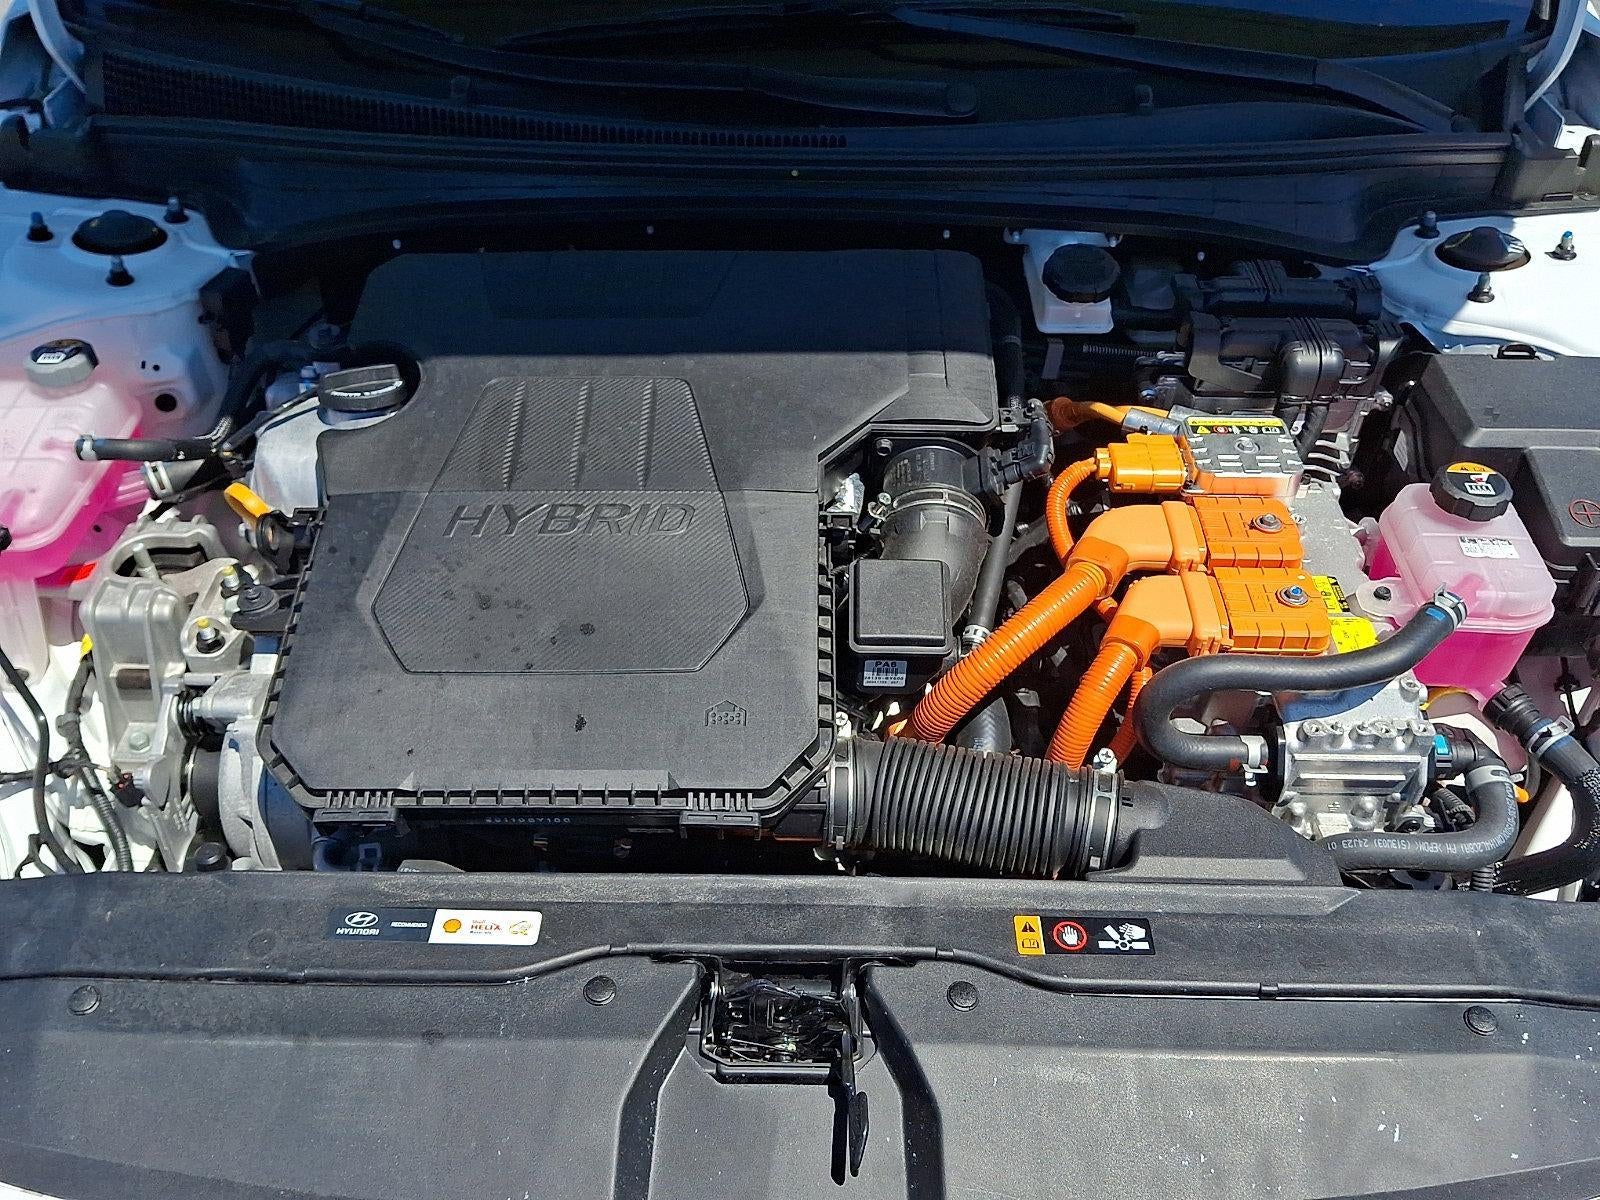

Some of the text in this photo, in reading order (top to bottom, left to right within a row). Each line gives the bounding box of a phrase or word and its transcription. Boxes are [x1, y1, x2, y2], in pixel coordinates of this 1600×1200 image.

[443, 503, 696, 537] HYBRID
[336, 927, 380, 936] HYUNDAI
[470, 923, 502, 931] HELIX
